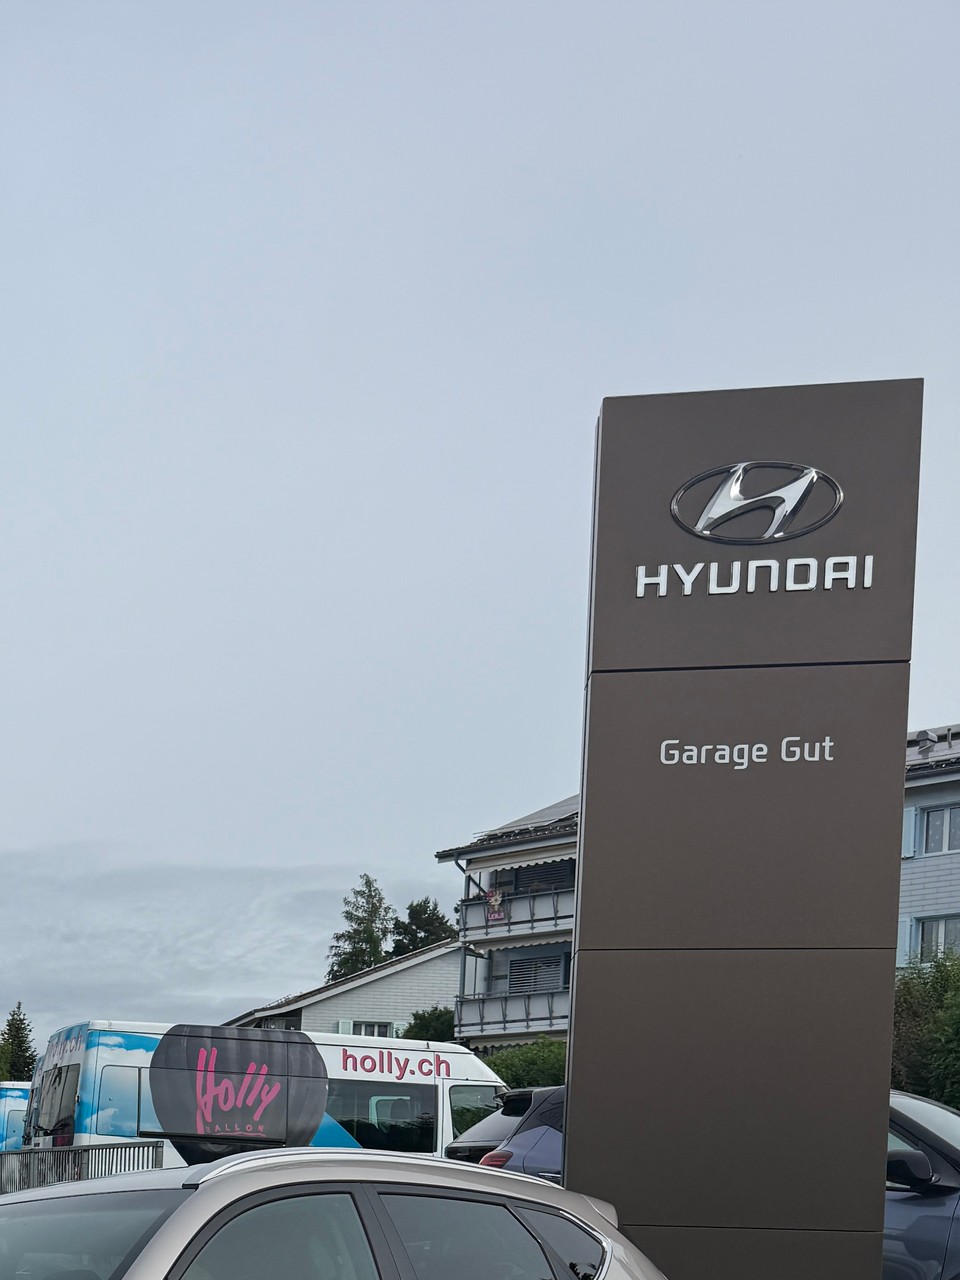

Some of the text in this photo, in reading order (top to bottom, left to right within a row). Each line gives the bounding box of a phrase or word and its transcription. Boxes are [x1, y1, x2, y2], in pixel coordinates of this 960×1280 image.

[635, 554, 874, 598] HYUNDAI
[660, 736, 835, 770] Garage Gut
[341, 1047, 451, 1080] holly.ch
[195, 1046, 281, 1135] Holly
